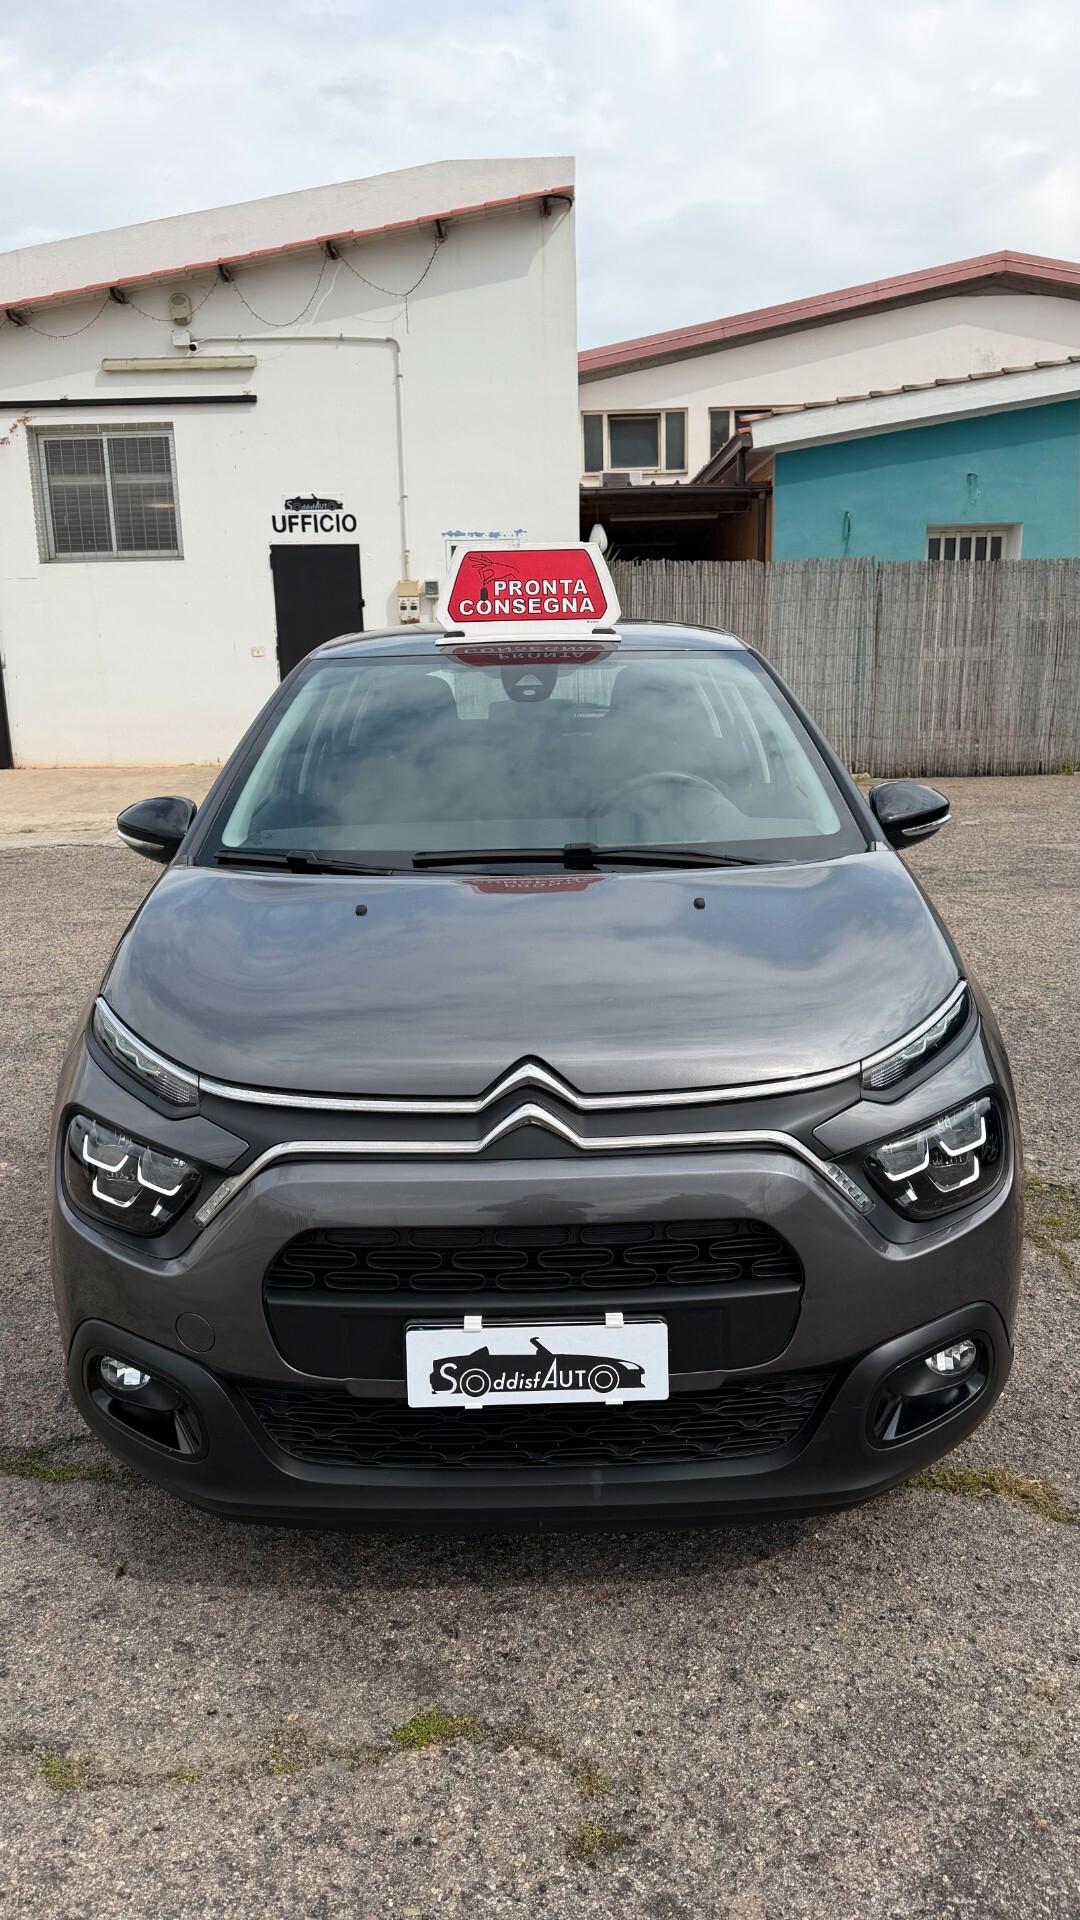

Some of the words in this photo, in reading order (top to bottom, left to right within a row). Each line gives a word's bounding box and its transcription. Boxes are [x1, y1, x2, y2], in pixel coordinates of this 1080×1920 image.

[272, 514, 357, 533] UFFICIO
[494, 579, 588, 596] PRONTA
[459, 597, 596, 616] CONSEGNA
